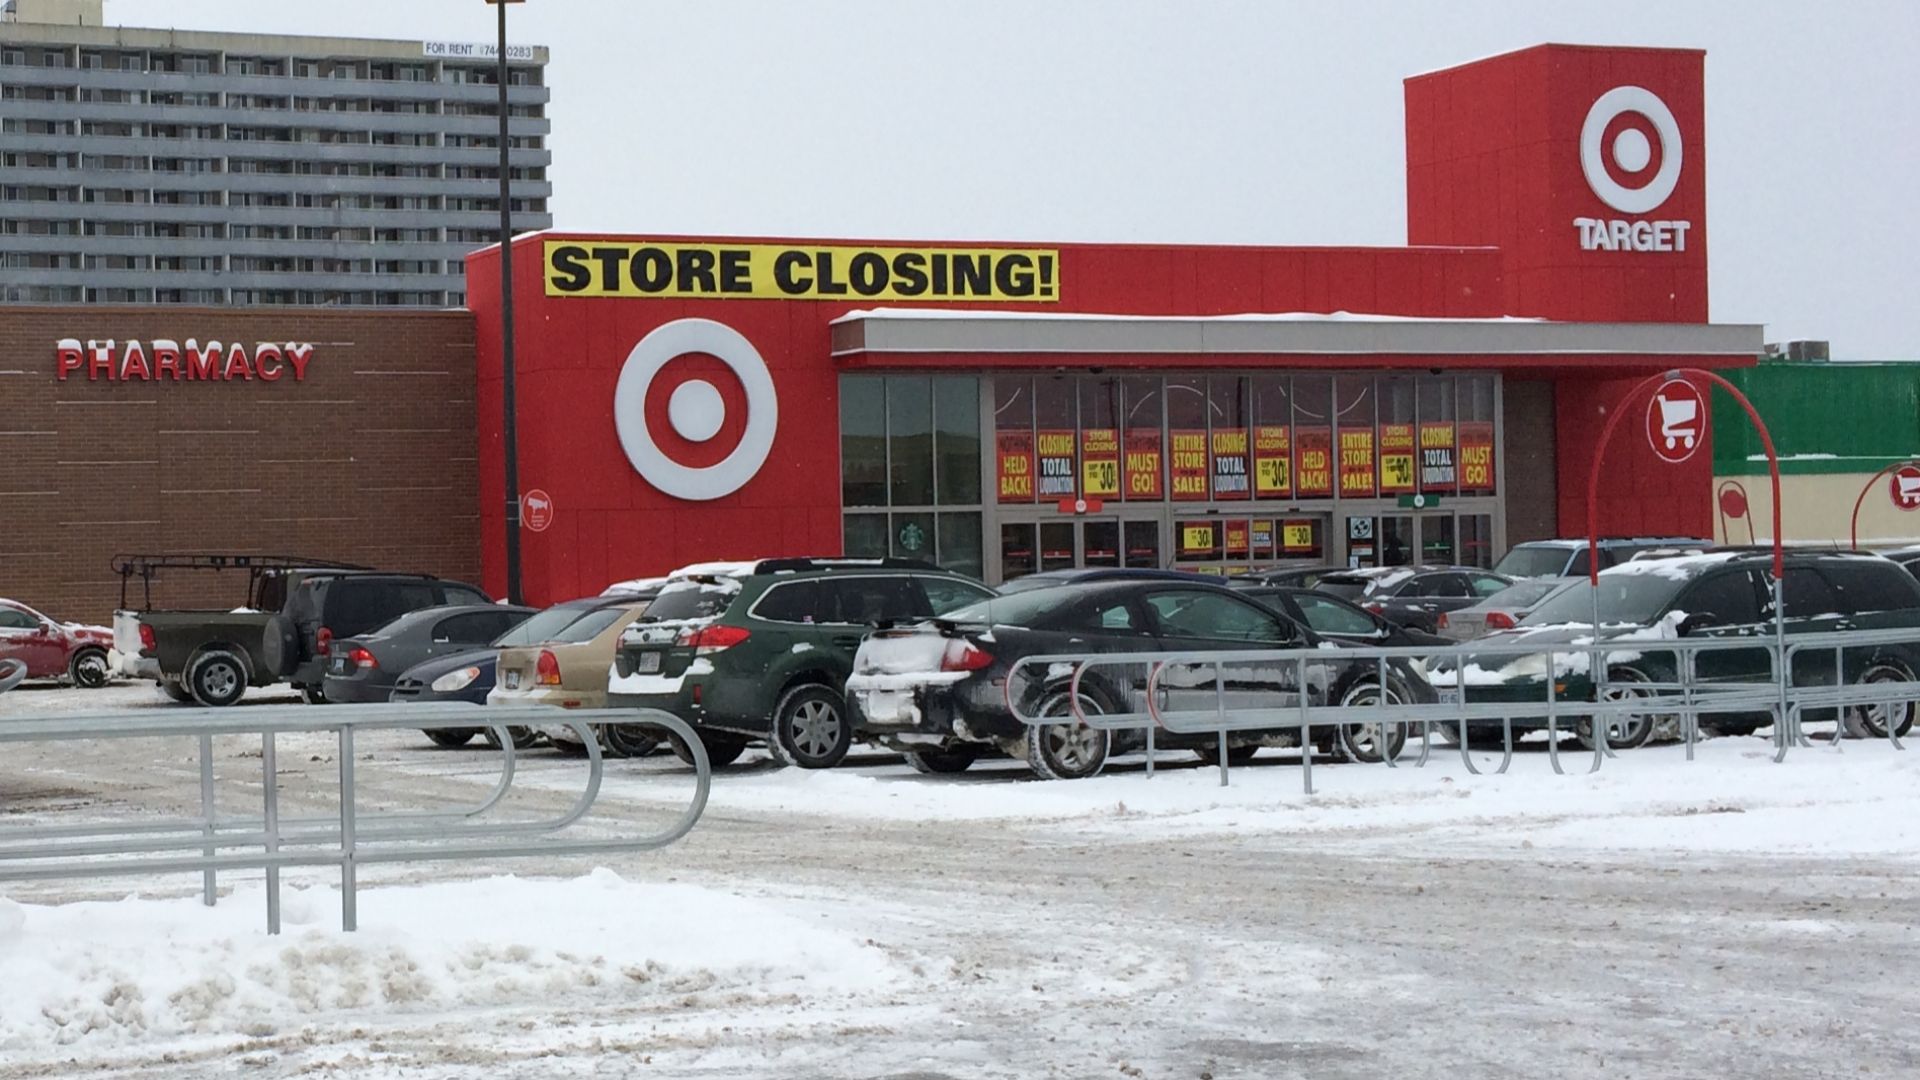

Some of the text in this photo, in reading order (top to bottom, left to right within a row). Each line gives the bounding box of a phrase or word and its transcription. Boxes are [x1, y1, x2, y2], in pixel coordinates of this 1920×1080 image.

[426, 42, 445, 54] FOR
[449, 44, 473, 55] RENT
[1573, 217, 1691, 252] TARGET
[550, 246, 1054, 297] STORE CLOSING!
[56, 338, 314, 381] PHARMACY
[1173, 435, 1204, 451] ENTIRE
[1342, 432, 1372, 448] ENTIRE
[1127, 453, 1158, 471] MUST
[1174, 452, 1204, 468] STORE
[1302, 451, 1325, 469] HELD
[1343, 450, 1372, 465] STORE
[1424, 449, 1452, 466] TOTAL
[1461, 447, 1491, 464] MUST
[1003, 456, 1028, 474] HELD
[1042, 458, 1072, 475] TOTAL
[1216, 456, 1245, 474] TOTAL
[1132, 473, 1155, 493] GO!
[1174, 476, 1205, 493] SALE!
[1300, 470, 1328, 490] BACK!
[1343, 473, 1373, 490] SALE!
[1466, 466, 1488, 485] GO!
[1001, 476, 1031, 496] BACK!
